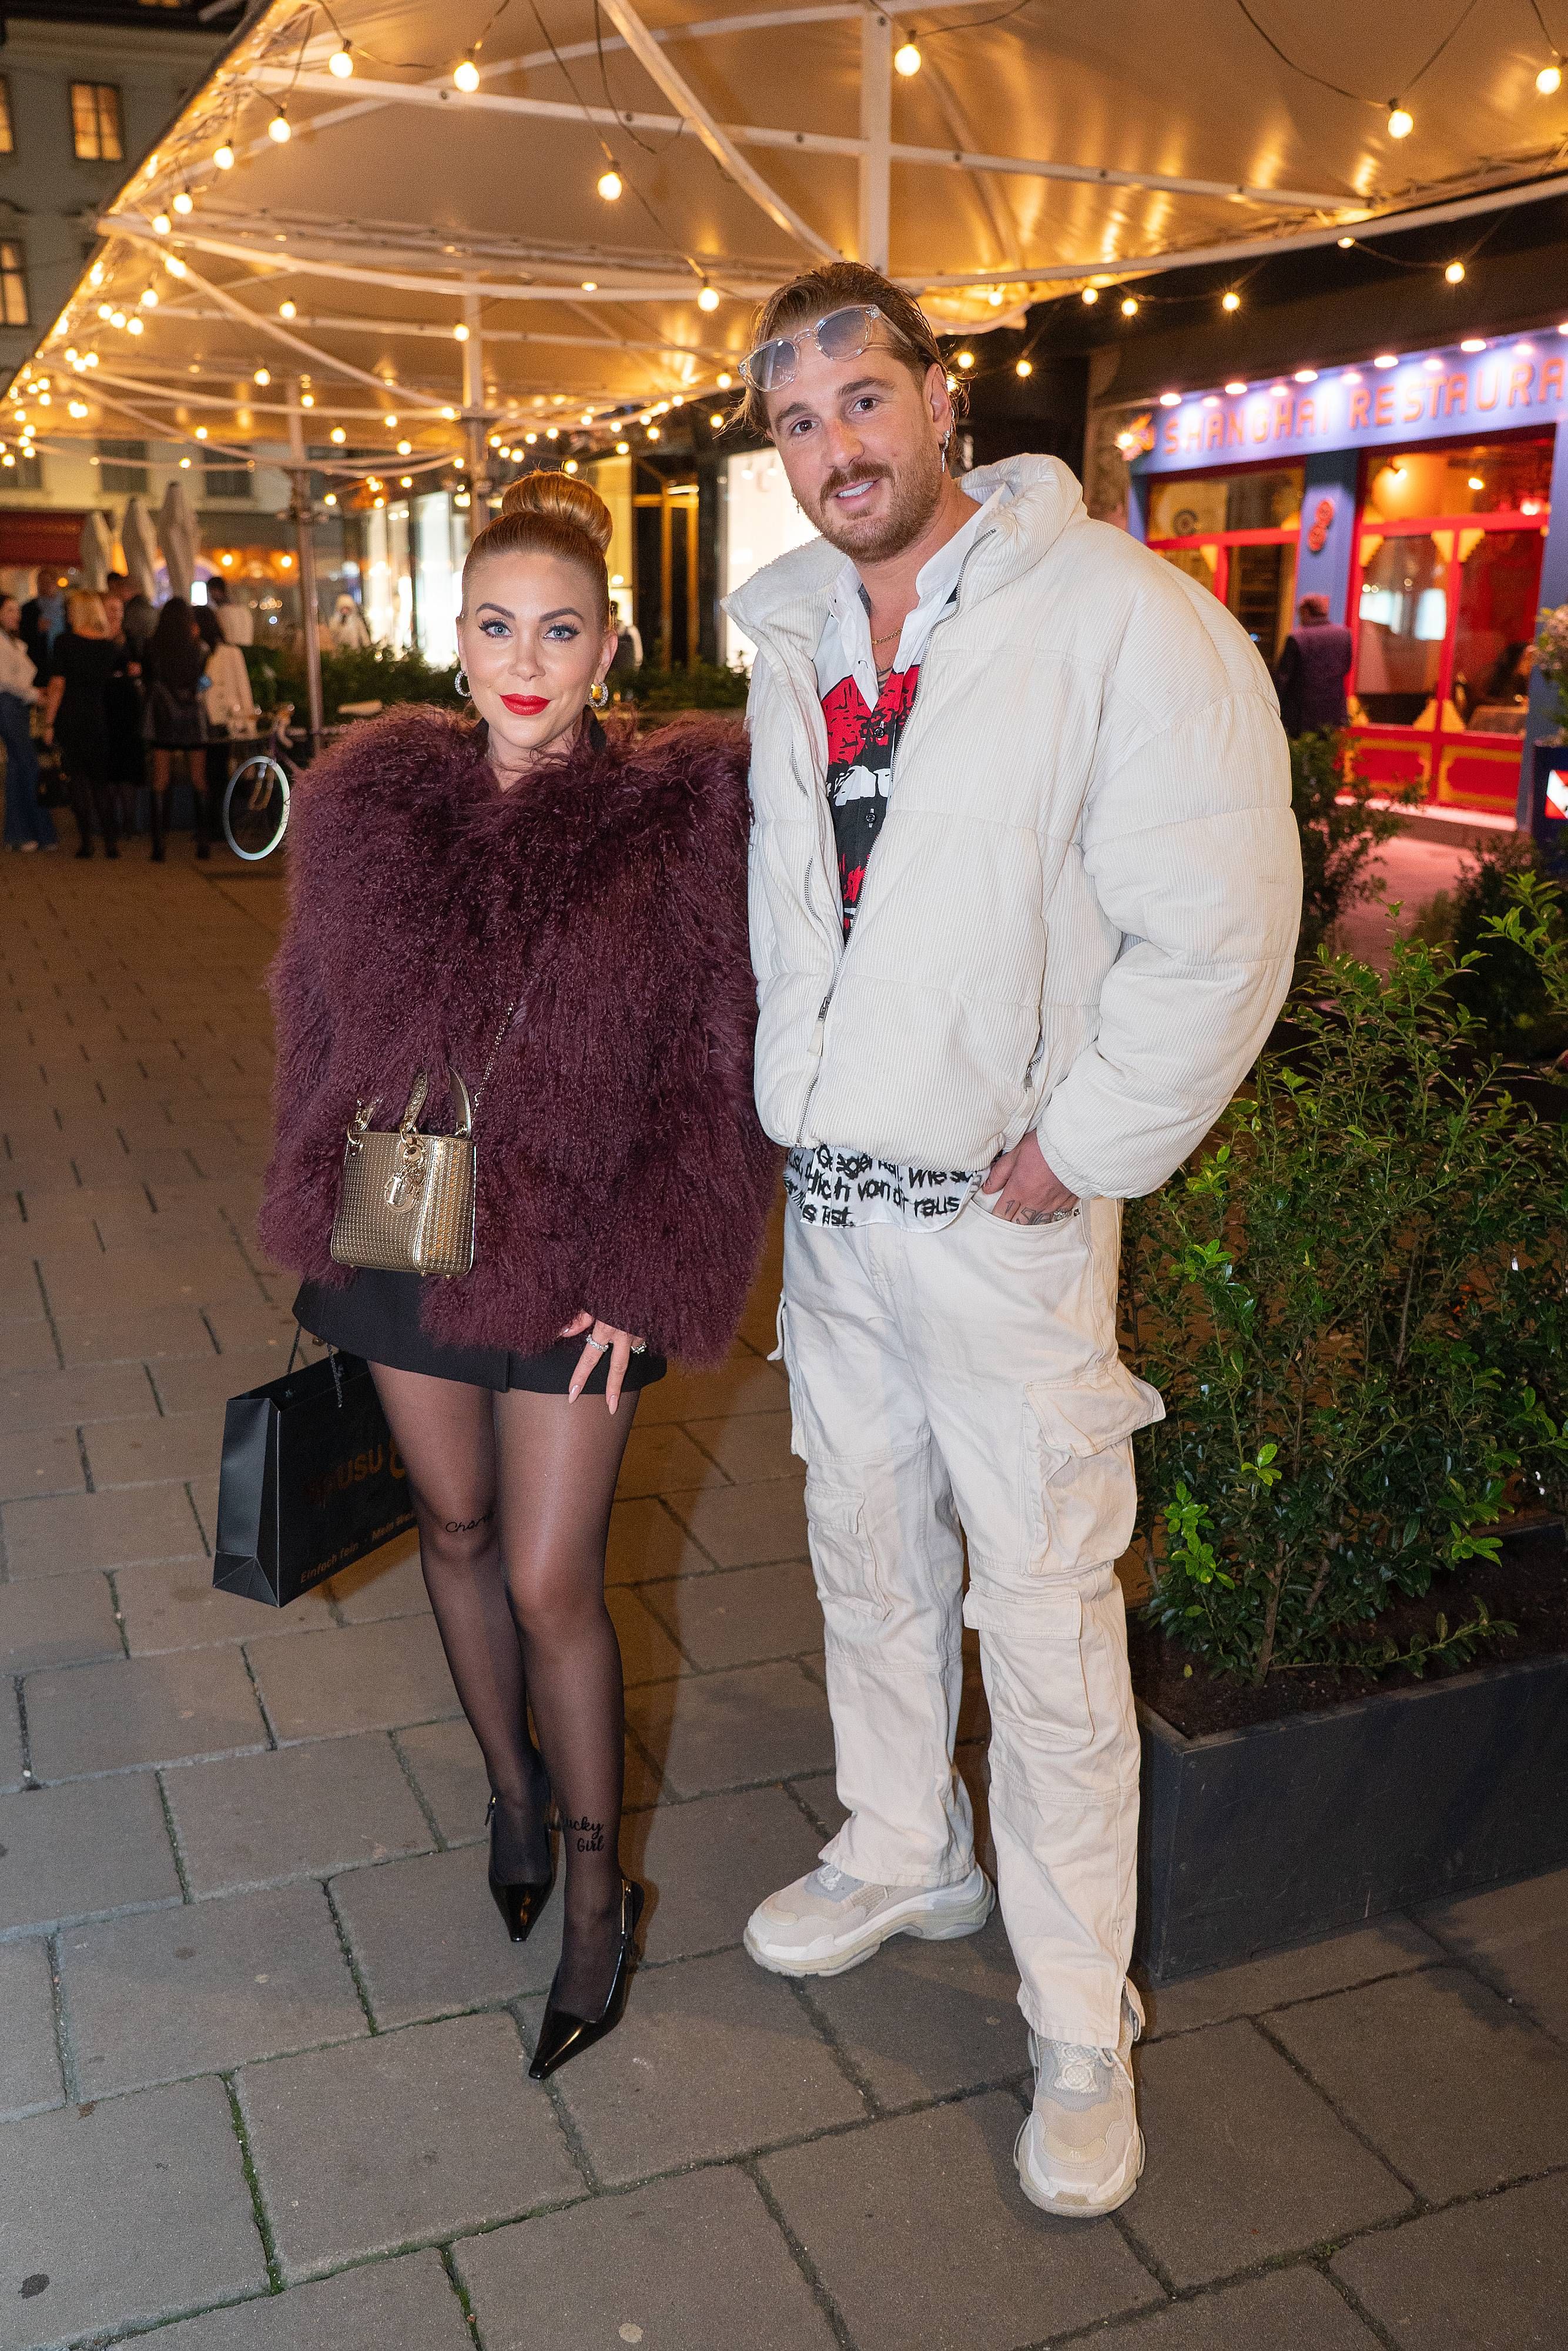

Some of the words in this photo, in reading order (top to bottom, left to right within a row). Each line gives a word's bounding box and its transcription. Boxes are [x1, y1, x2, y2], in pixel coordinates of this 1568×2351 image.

[1164, 396, 1329, 454] SHANGHAI
[1348, 357, 1564, 430] RESTAURA
[858, 1179, 890, 1201] von
[914, 1195, 960, 1218] raus
[565, 1816, 605, 1840] ucky
[577, 1835, 605, 1853] Girl
